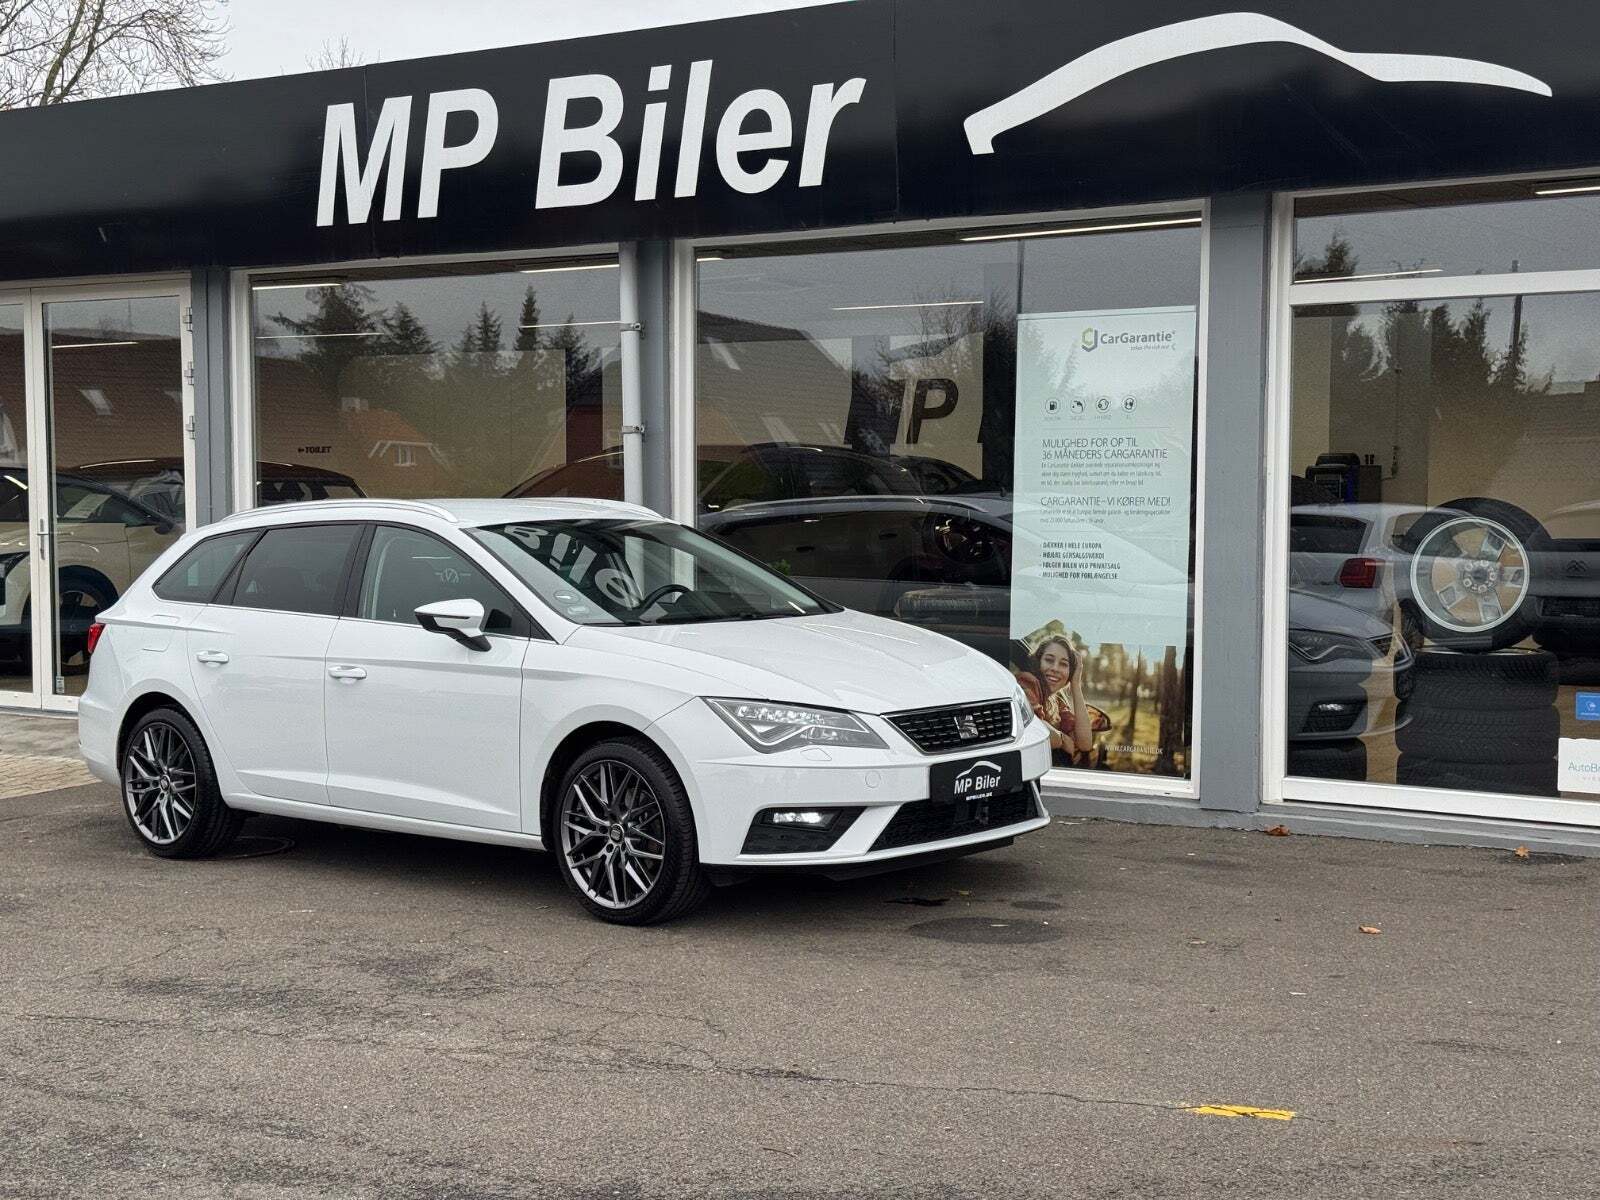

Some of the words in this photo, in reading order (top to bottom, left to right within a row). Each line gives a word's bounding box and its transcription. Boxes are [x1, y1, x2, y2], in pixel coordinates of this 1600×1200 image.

[316, 88, 499, 227] MP
[535, 59, 867, 210] Biler
[1100, 331, 1172, 344] CarGarantie
[1042, 438, 1088, 449] MULIGHED
[1090, 438, 1108, 448] FOR
[1110, 438, 1124, 447] OP
[1126, 437, 1138, 447] TIL
[305, 446, 332, 454] TOILET
[1042, 450, 1053, 460] 36
[1054, 448, 1102, 460] MÅNEDERS
[1104, 449, 1168, 459] CARGARANTIE
[1040, 497, 1100, 507] CARGARANTIE
[1117, 496, 1145, 506] KØRER
[1147, 497, 1171, 507] MED!
[954, 778, 972, 794] MP
[975, 774, 1001, 790] Biler
